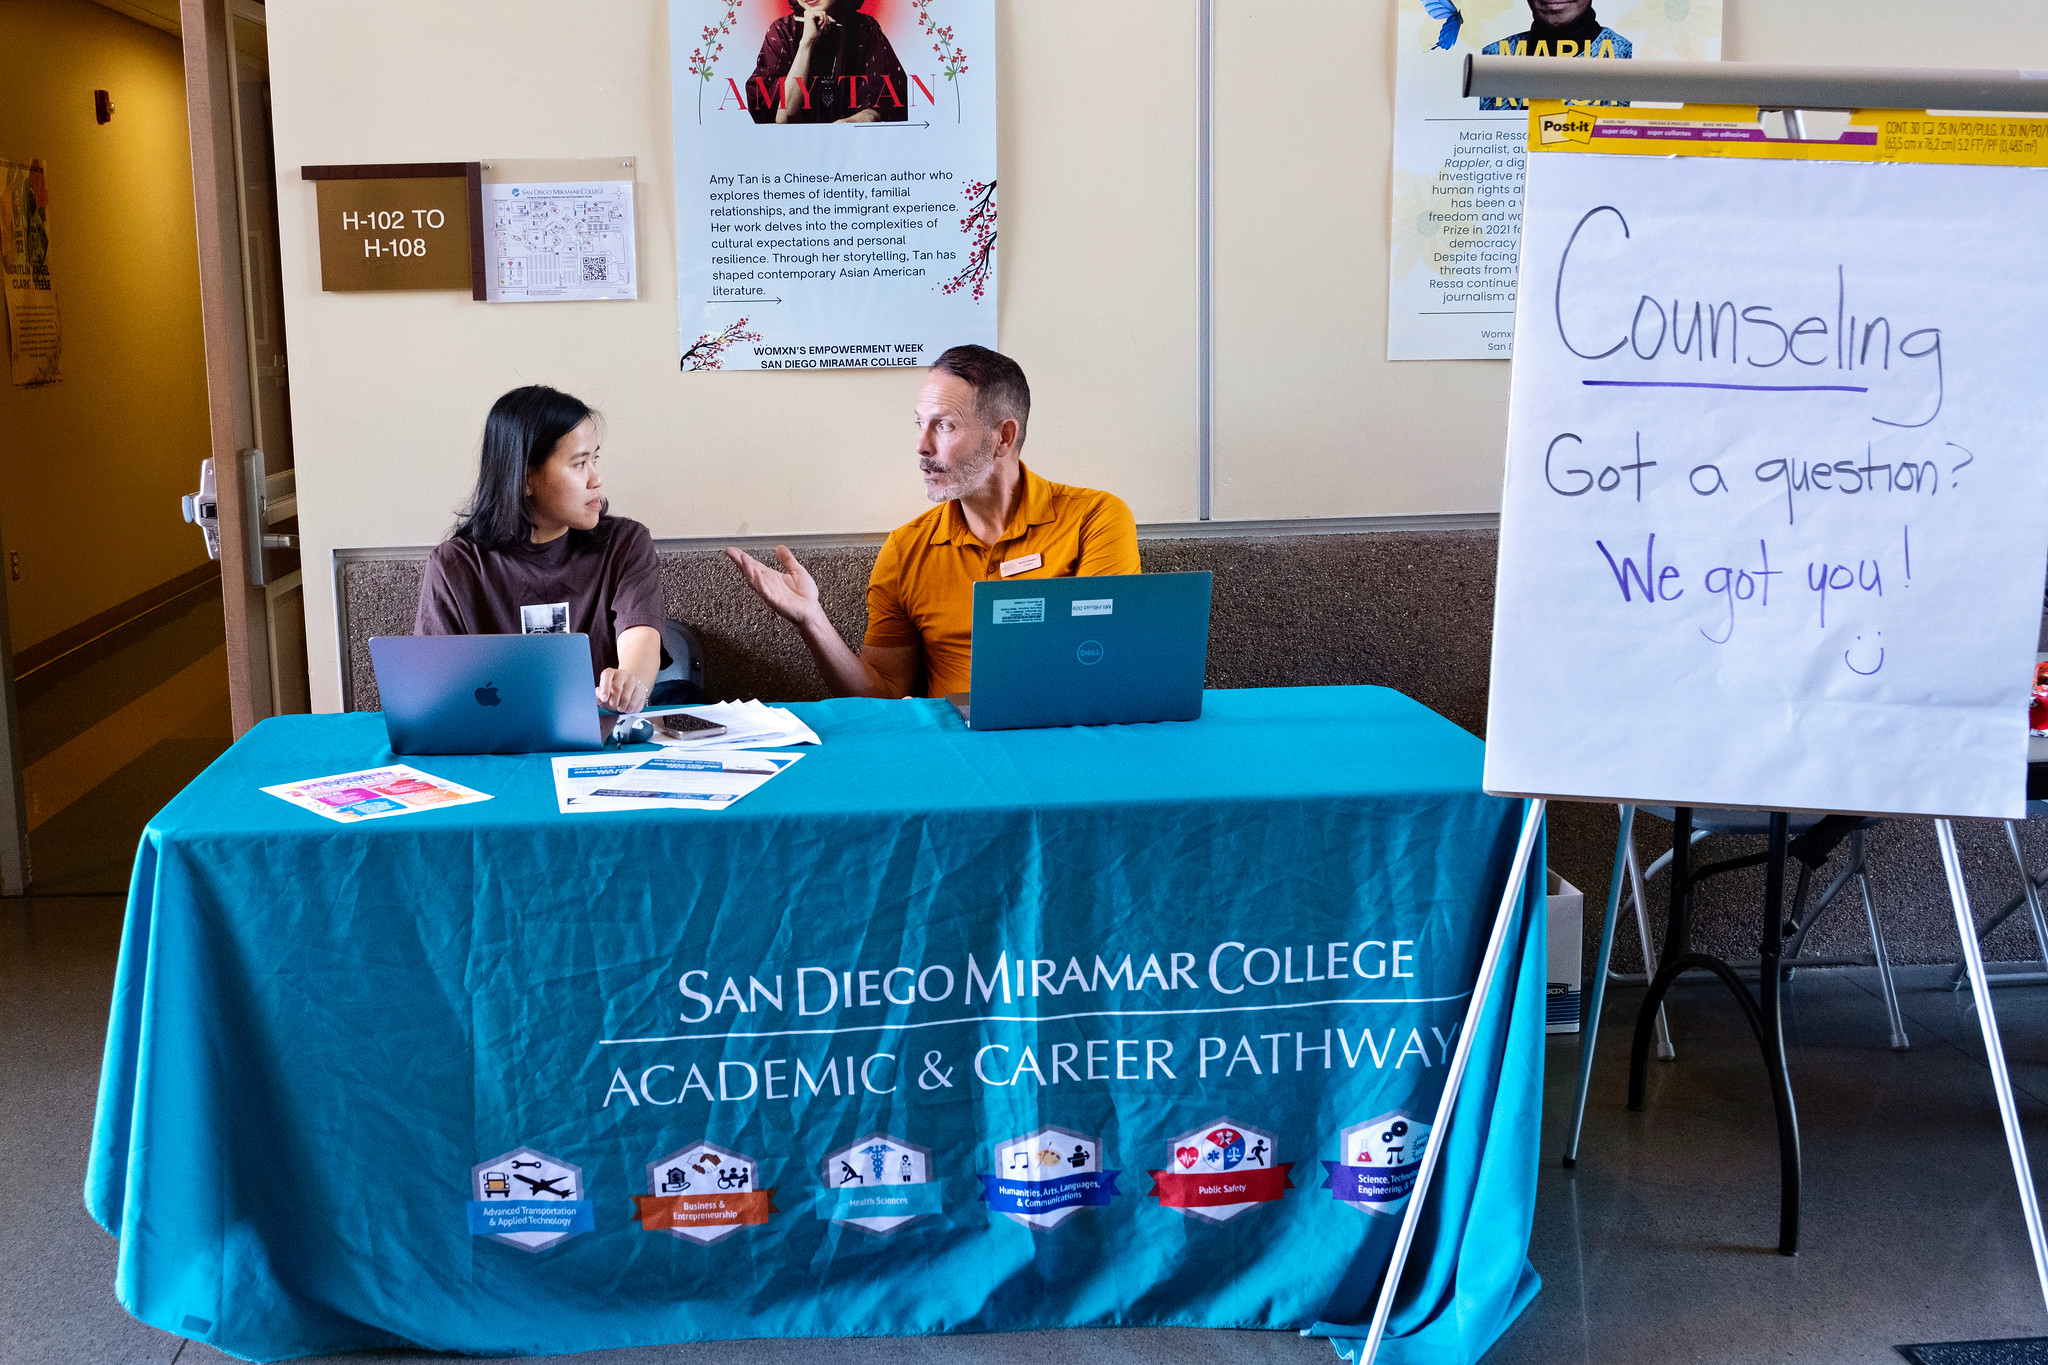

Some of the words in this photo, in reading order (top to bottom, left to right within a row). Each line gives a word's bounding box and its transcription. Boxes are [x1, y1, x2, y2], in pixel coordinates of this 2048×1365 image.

[718, 77, 820, 110] AMY
[837, 73, 937, 109] TAN
[1543, 120, 1589, 132] Post-it
[1620, 128, 1637, 136] sticky
[1459, 131, 1492, 140] Maria
[1453, 144, 1510, 157] journalist,
[1444, 158, 1492, 170] Rappler,
[1495, 160, 1503, 168] a
[710, 174, 734, 186] Amy
[738, 174, 758, 184] Tan
[761, 174, 770, 184] is
[773, 176, 781, 184] a
[784, 171, 887, 184] Chinese-American
[890, 170, 926, 182] author
[930, 170, 953, 181] who
[1439, 171, 1513, 183] investigative
[710, 189, 760, 202] explores
[763, 189, 805, 200] themes
[808, 188, 820, 199] of
[823, 187, 868, 200] identity,
[871, 186, 910, 198] familial
[1432, 185, 1474, 194] human
[1477, 184, 1510, 197] rights
[1451, 198, 1472, 207] has
[1476, 198, 1505, 207] been
[710, 206, 786, 218] relationships,
[789, 205, 809, 215] and
[813, 204, 831, 215] the
[834, 203, 889, 216] immigrant
[893, 202, 959, 215] experience.
[343, 210, 404, 231] H-102
[412, 209, 445, 229] TO
[1429, 212, 1478, 221] freedom
[1482, 212, 1505, 221] and
[711, 222, 731, 232] Her
[734, 222, 761, 232] work
[765, 220, 802, 232] delves
[805, 220, 826, 230] into
[830, 220, 848, 230] the
[851, 218, 923, 233] complexities
[926, 218, 938, 228] of
[1443, 225, 1470, 235] Prize
[1473, 225, 1483, 234] in
[1486, 225, 1510, 234] 2021
[364, 238, 426, 258] H-108
[711, 238, 753, 249] cultural
[756, 236, 830, 249] expectations
[833, 236, 853, 246] and
[857, 235, 906, 248] personal
[1449, 239, 1516, 250] democracy
[712, 253, 769, 264] resilience.
[773, 253, 819, 266] Through
[822, 252, 841, 263] her
[843, 251, 909, 264] storytelling,
[913, 250, 933, 260] Tan
[937, 250, 956, 260] has
[1434, 252, 1477, 264] Despite
[1480, 252, 1517, 263] facing
[712, 269, 754, 282] shaped
[757, 269, 836, 281] contemporary
[839, 267, 870, 277] Asian
[873, 267, 926, 277] American
[1440, 265, 1481, 275] threats
[1484, 265, 1512, 274] from
[1429, 279, 1463, 288] Ressa
[713, 285, 766, 296] literature.
[1442, 292, 1504, 304] journalism
[1555, 205, 1943, 428] Counseling
[753, 346, 806, 356] WOMXN'S
[809, 344, 892, 355] EMPOWERMENT
[894, 344, 924, 354] WEEK
[1488, 343, 1506, 351] San
[761, 359, 783, 369] SAN
[785, 359, 817, 369] DIEGO
[820, 358, 869, 368] MIRAMAR
[871, 356, 918, 367] COLLEGE
[1545, 431, 1657, 502] Got
[1689, 463, 1728, 496] a
[1755, 440, 1974, 526] question?
[1596, 533, 1684, 602] We
[1700, 538, 1784, 644] got
[1080, 649, 1101, 657] DELL
[679, 968, 783, 1023] SAN
[796, 963, 955, 1018] DIEGO
[964, 950, 1200, 1005] MIRAMAR
[1208, 940, 1415, 994] COLLEGE
[602, 1053, 896, 1109] ACADEMIC
[917, 1050, 954, 1088] &
[973, 1037, 1177, 1087] CAREER
[1199, 1021, 1464, 1078] PATHWAY
[1358, 1174, 1390, 1184] Science,
[999, 1186, 1041, 1198] Humanities,
[1042, 1187, 1058, 1197] Arts,
[1060, 1180, 1100, 1195] Languages,
[1198, 1184, 1221, 1194] Public
[1223, 1184, 1246, 1194] Safety
[849, 1197, 873, 1207] Health
[875, 1196, 907, 1206] Sciences
[1017, 1198, 1023, 1206] &
[1025, 1191, 1082, 1207] Communications
[483, 1206, 519, 1217] Advanced
[521, 1205, 577, 1217] Transportation
[683, 1201, 716, 1211] Business
[718, 1201, 726, 1209] &
[489, 1217, 495, 1225] &
[496, 1216, 525, 1227] Applied
[526, 1215, 572, 1227] Technology
[673, 1209, 738, 1221] Entrepreneurship
